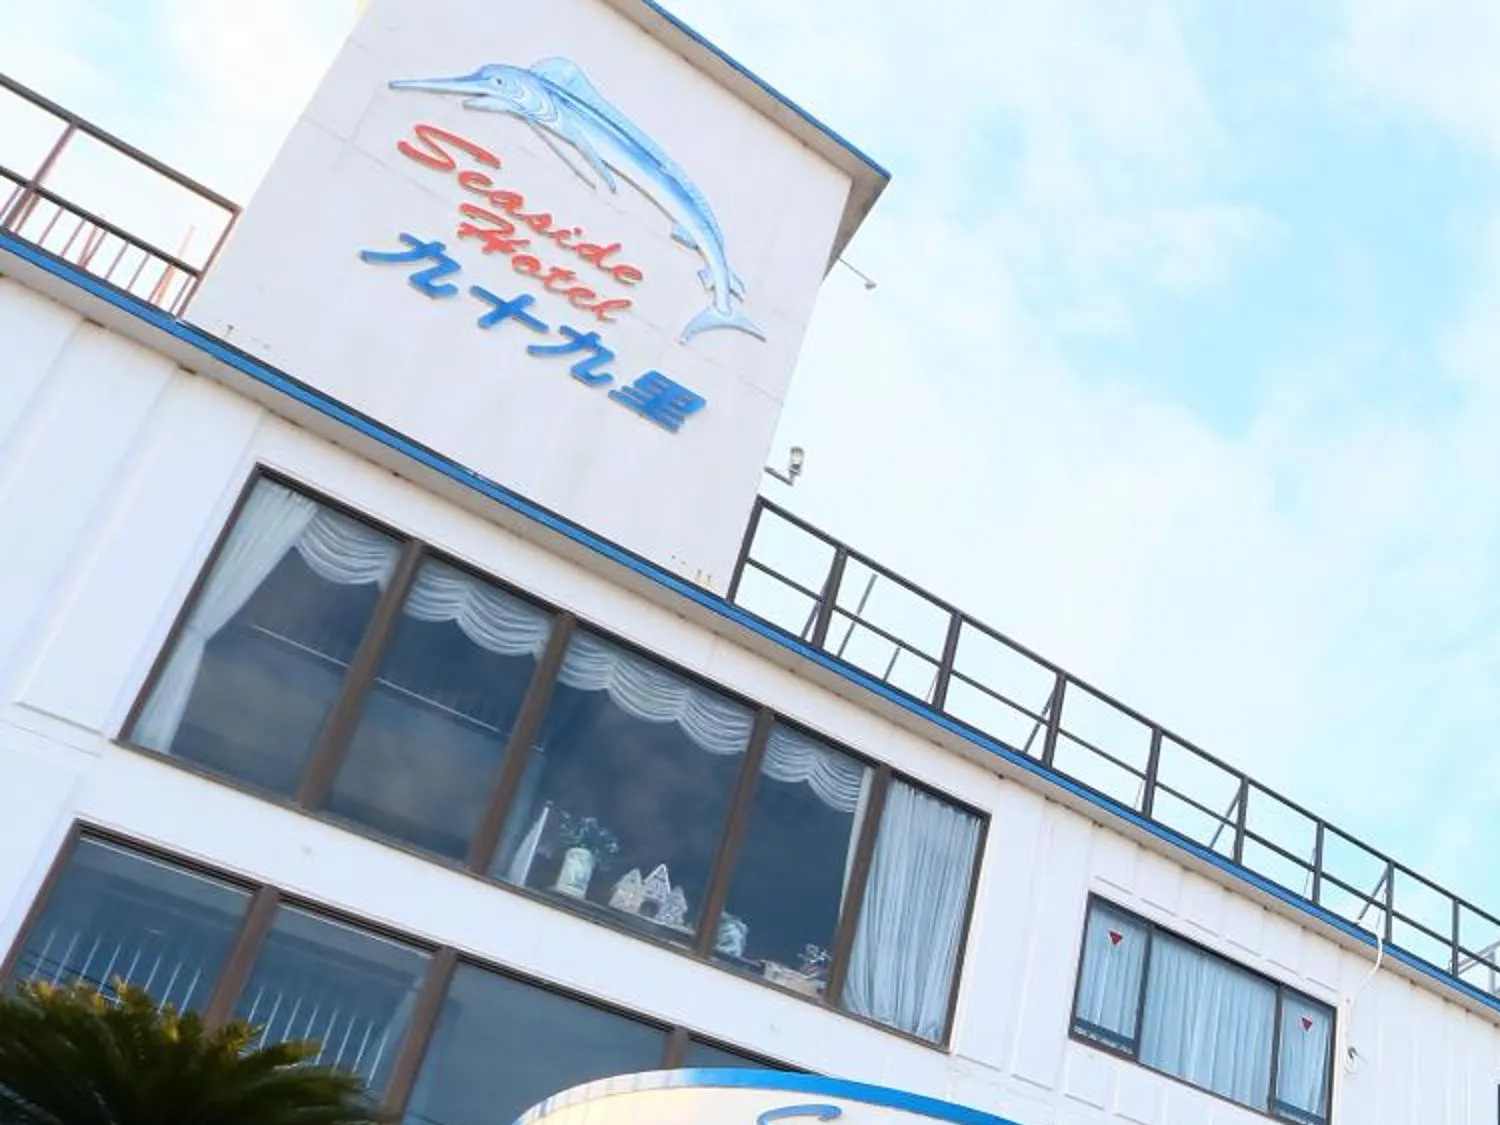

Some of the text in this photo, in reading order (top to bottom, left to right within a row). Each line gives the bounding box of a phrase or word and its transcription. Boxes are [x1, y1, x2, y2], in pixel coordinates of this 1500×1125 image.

[398, 125, 643, 287] Seaside
[457, 203, 633, 322] Hotel
[360, 232, 707, 433] 九十九里
